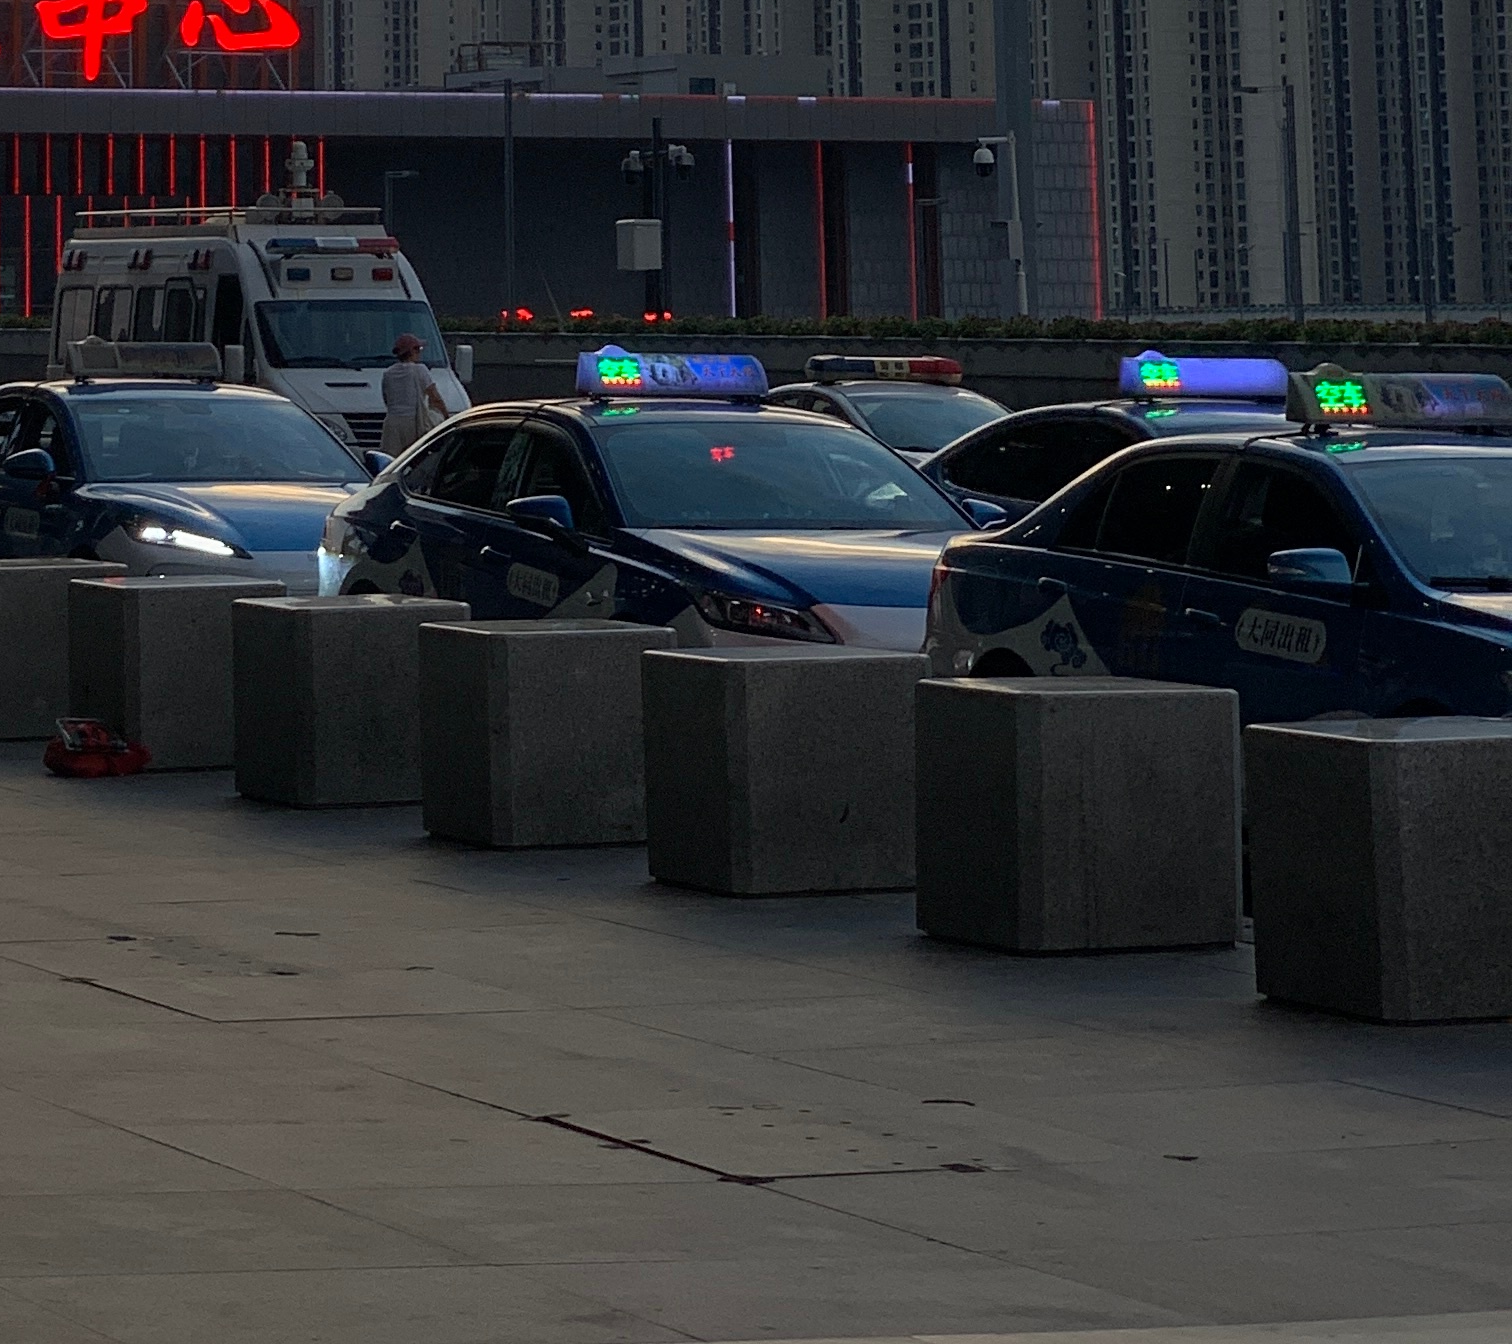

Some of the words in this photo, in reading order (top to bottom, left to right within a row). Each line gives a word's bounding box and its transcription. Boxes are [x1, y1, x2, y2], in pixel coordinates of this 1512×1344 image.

[1316, 381, 1366, 408] 空车
[1248, 616, 1312, 653] 大同出租
